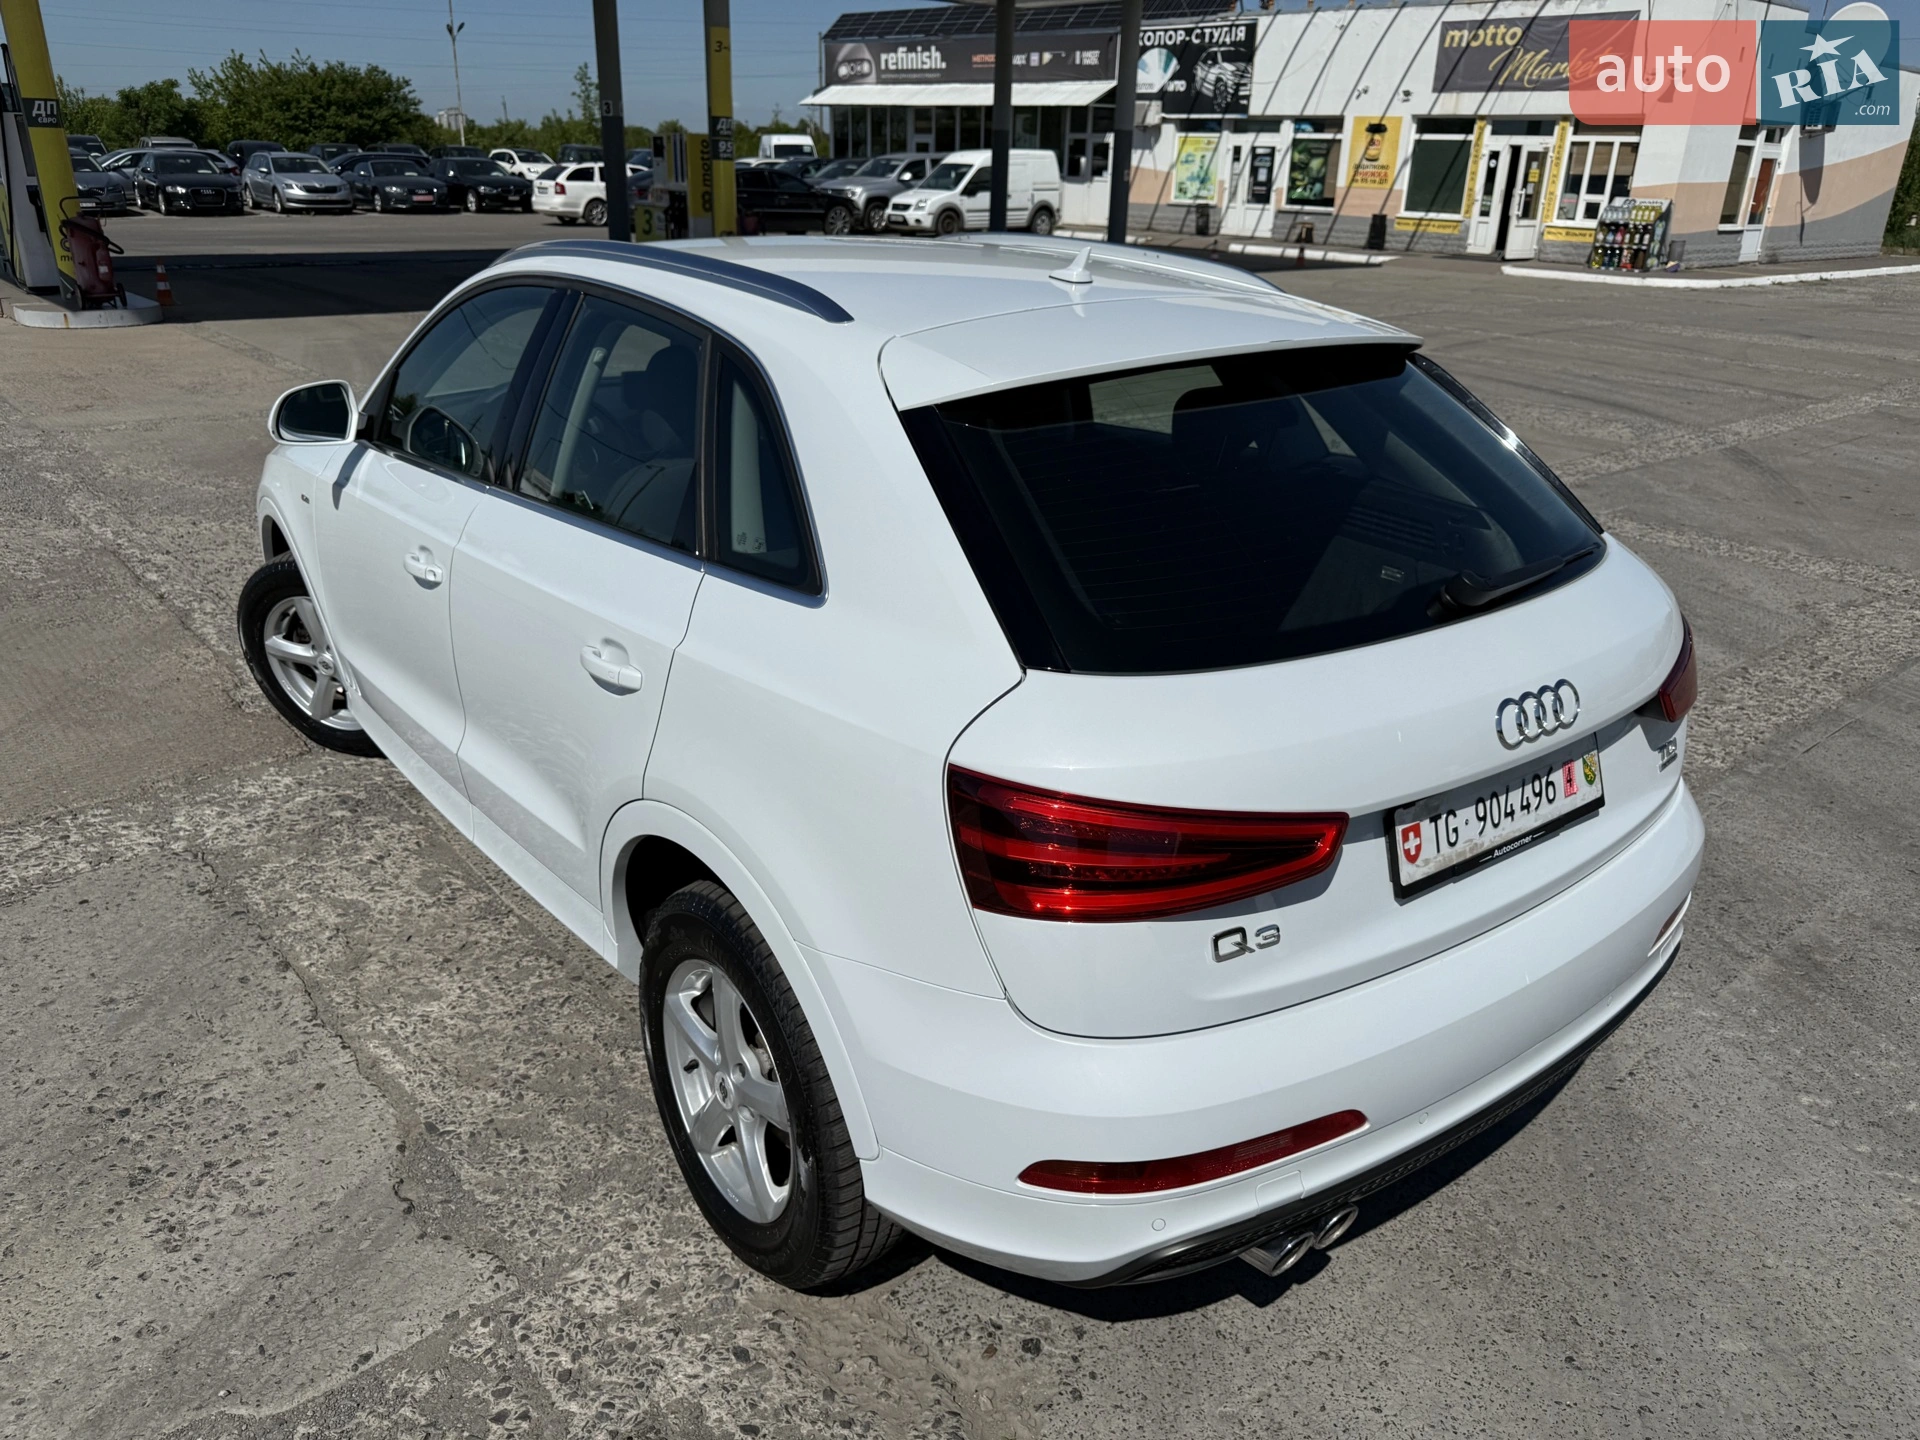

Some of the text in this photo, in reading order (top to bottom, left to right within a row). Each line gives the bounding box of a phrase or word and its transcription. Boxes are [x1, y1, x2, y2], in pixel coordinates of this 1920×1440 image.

[1444, 23, 1523, 48] motto
[880, 45, 947, 70] refinish.
[32, 100, 57, 117] ДП
[603, 101, 611, 115] 3
[718, 141, 733, 151] 95
[700, 139, 712, 187] motto
[643, 209, 653, 235] 3
[1492, 834, 1534, 858] Autocorner
[1210, 923, 1281, 963] Q3
